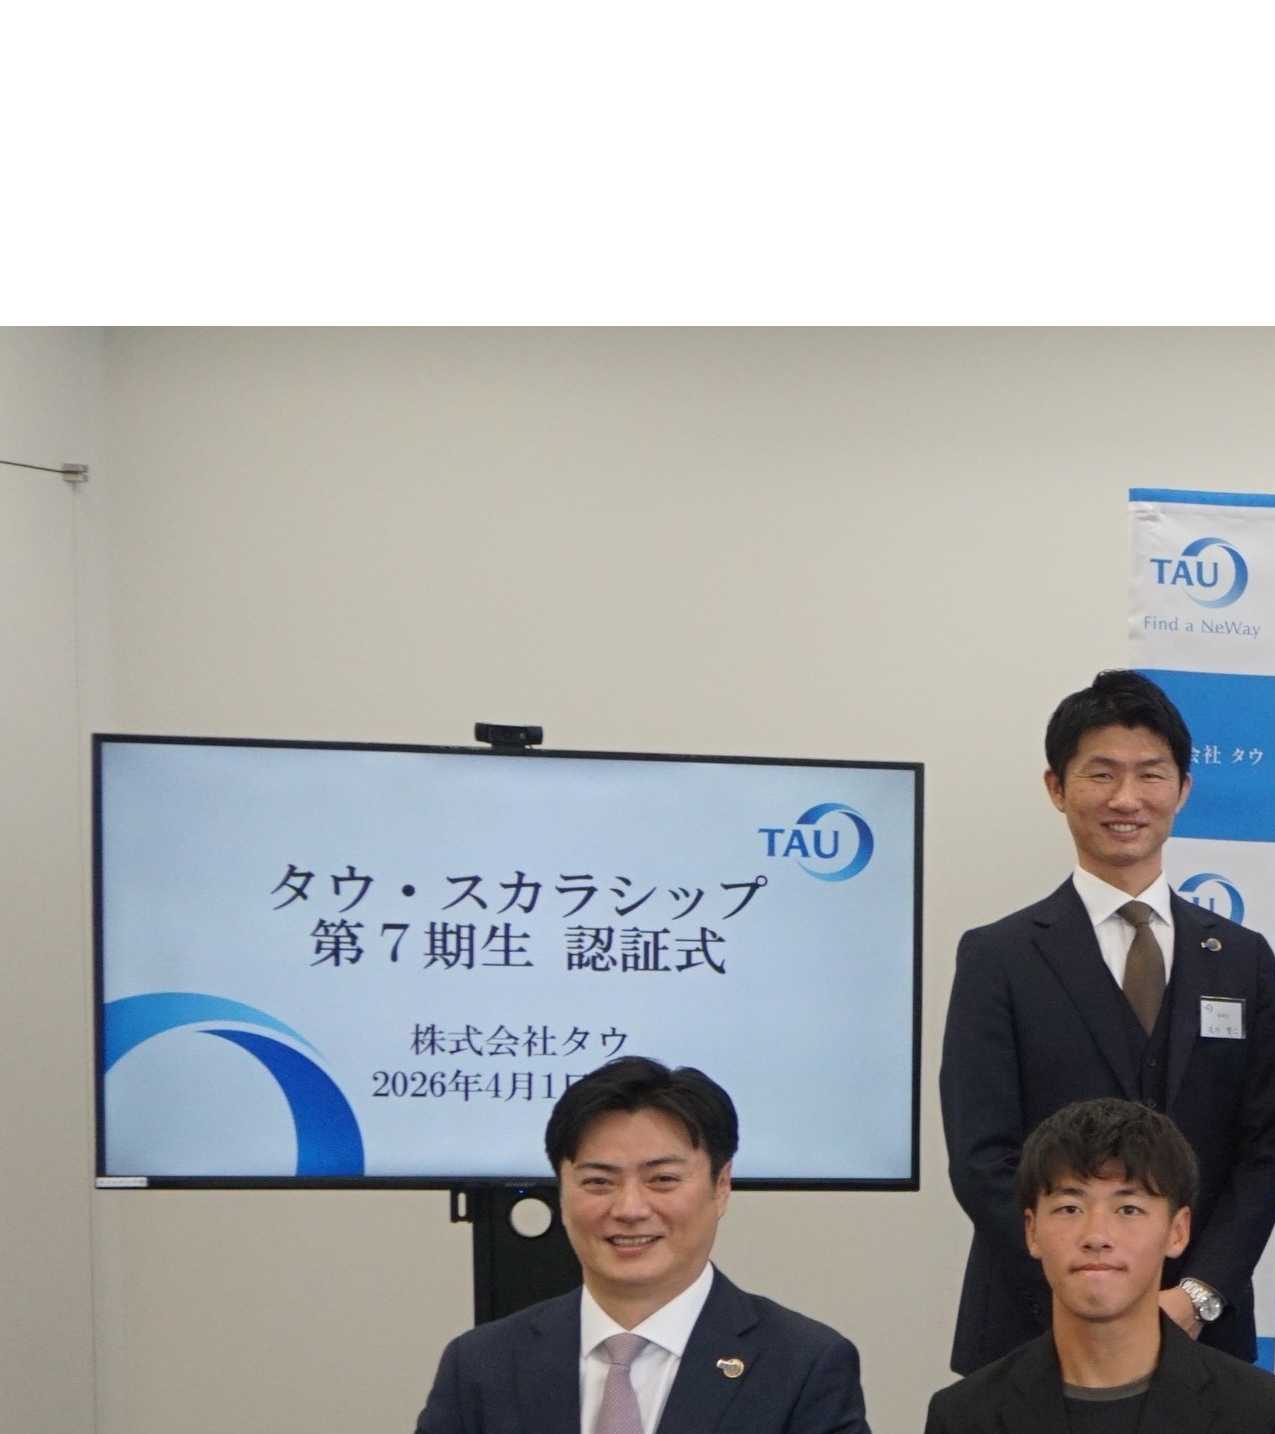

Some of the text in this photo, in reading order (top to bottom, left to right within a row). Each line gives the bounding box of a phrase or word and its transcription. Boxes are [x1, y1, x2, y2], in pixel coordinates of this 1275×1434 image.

[1150, 559, 1218, 587] TAU
[1142, 616, 1260, 639] Find a NeWay
[1232, 748, 1263, 764] タウ
[758, 827, 840, 861] TAU
[270, 864, 768, 920] タウ・スカラシップ
[311, 919, 726, 974] 第7期生 認証式
[411, 1024, 627, 1057] 株式会社タウ
